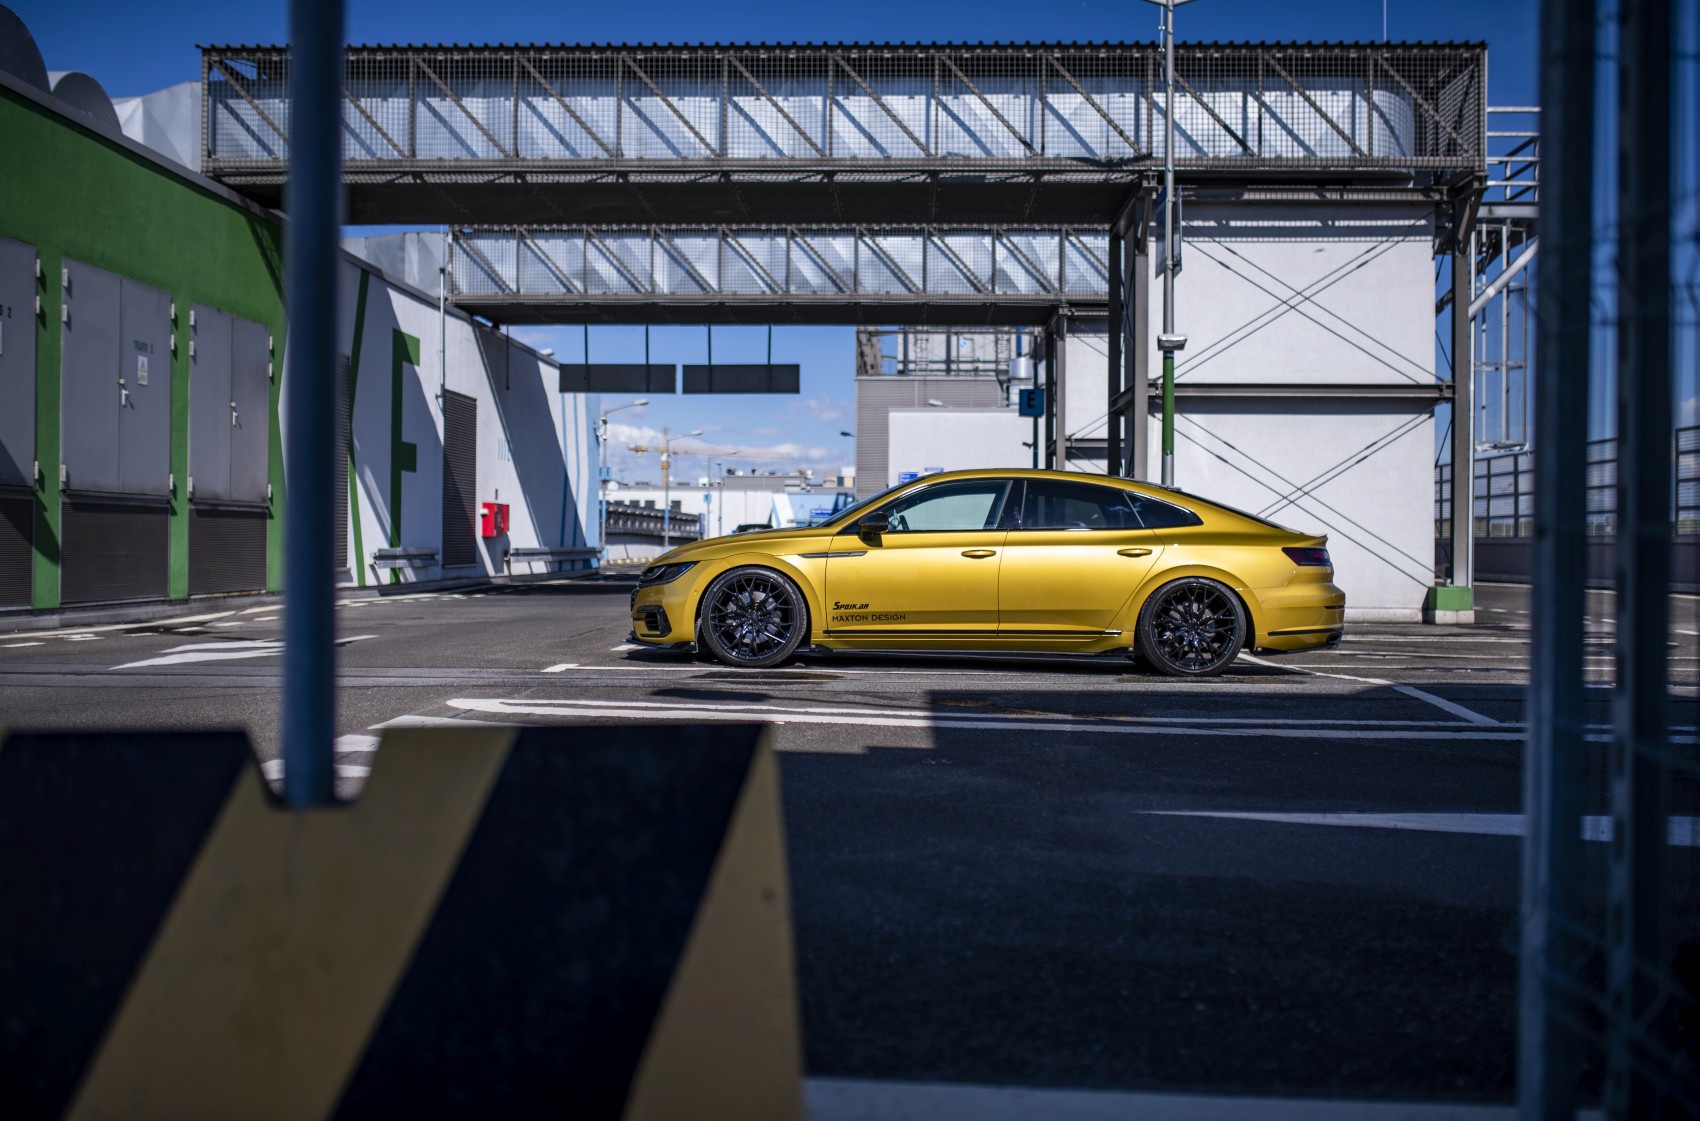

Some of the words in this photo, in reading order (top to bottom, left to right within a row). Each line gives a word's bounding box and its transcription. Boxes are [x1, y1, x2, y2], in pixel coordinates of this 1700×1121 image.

[7, 306, 12, 319] 2
[1027, 391, 1036, 409] E
[832, 614, 869, 622] MAXTON
[871, 613, 906, 621] DESIGN
